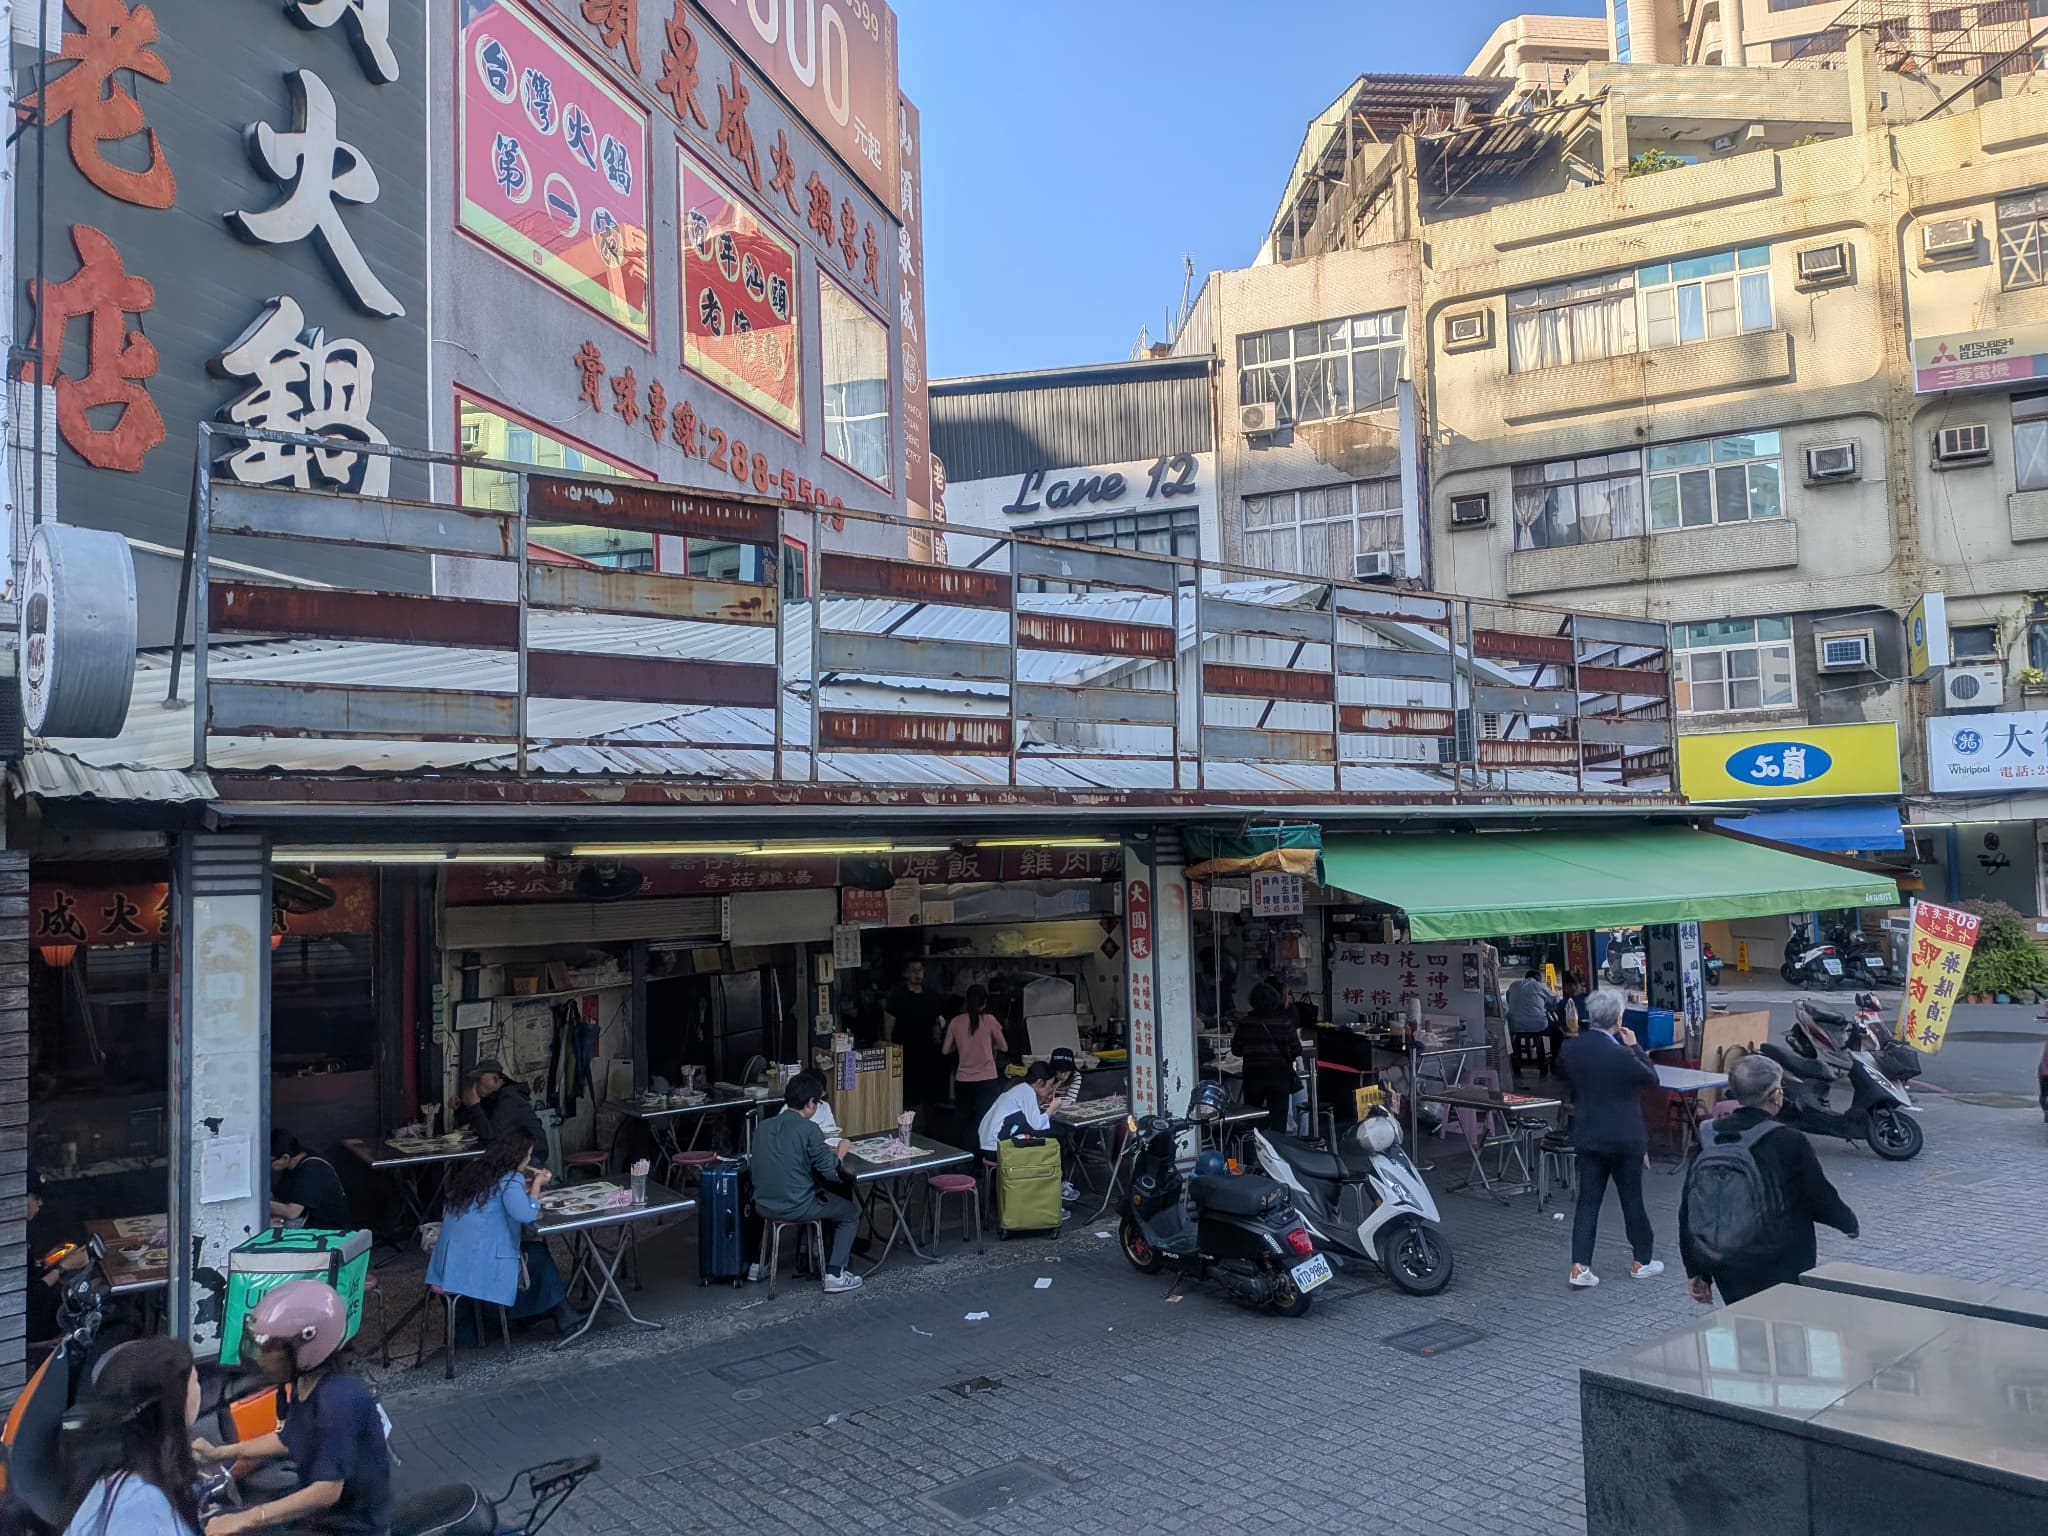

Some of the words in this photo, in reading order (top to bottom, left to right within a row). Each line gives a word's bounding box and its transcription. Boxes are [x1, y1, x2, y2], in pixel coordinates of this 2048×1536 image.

[482, 39, 632, 197] 台灣火鍋
[1959, 337, 2015, 352] MITSUBISHI
[1959, 346, 2008, 361] ELECTRIC
[1937, 361, 2011, 385] 三菱電機
[1145, 451, 1200, 498] 12
[1948, 764, 1990, 775] Whirlpool
[2000, 765, 2048, 778] 電話:2
[1427, 954, 1449, 1010] 四神湯
